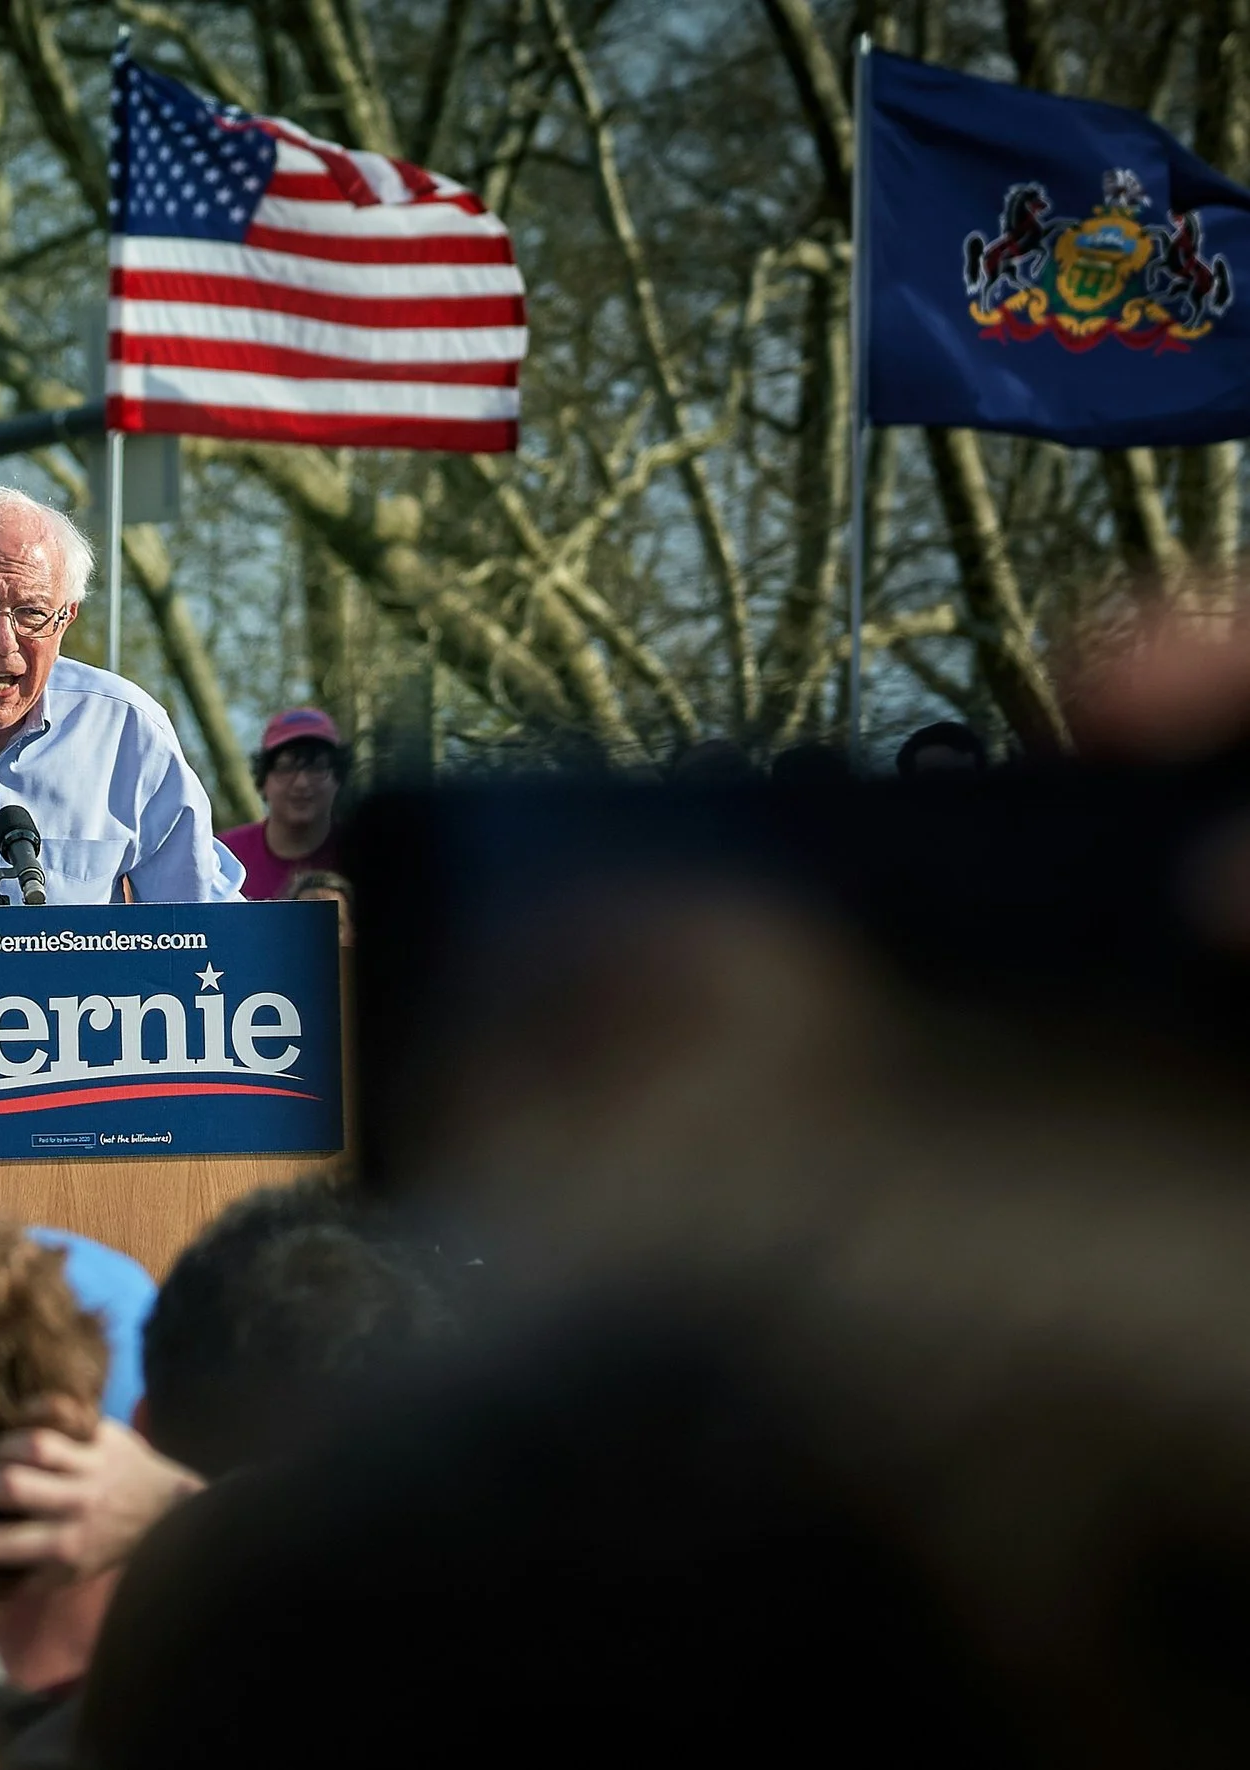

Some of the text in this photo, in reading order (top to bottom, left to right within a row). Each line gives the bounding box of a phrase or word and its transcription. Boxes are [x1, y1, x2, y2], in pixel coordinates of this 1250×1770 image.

[100, 1131, 173, 1146] (not the billionaires)
